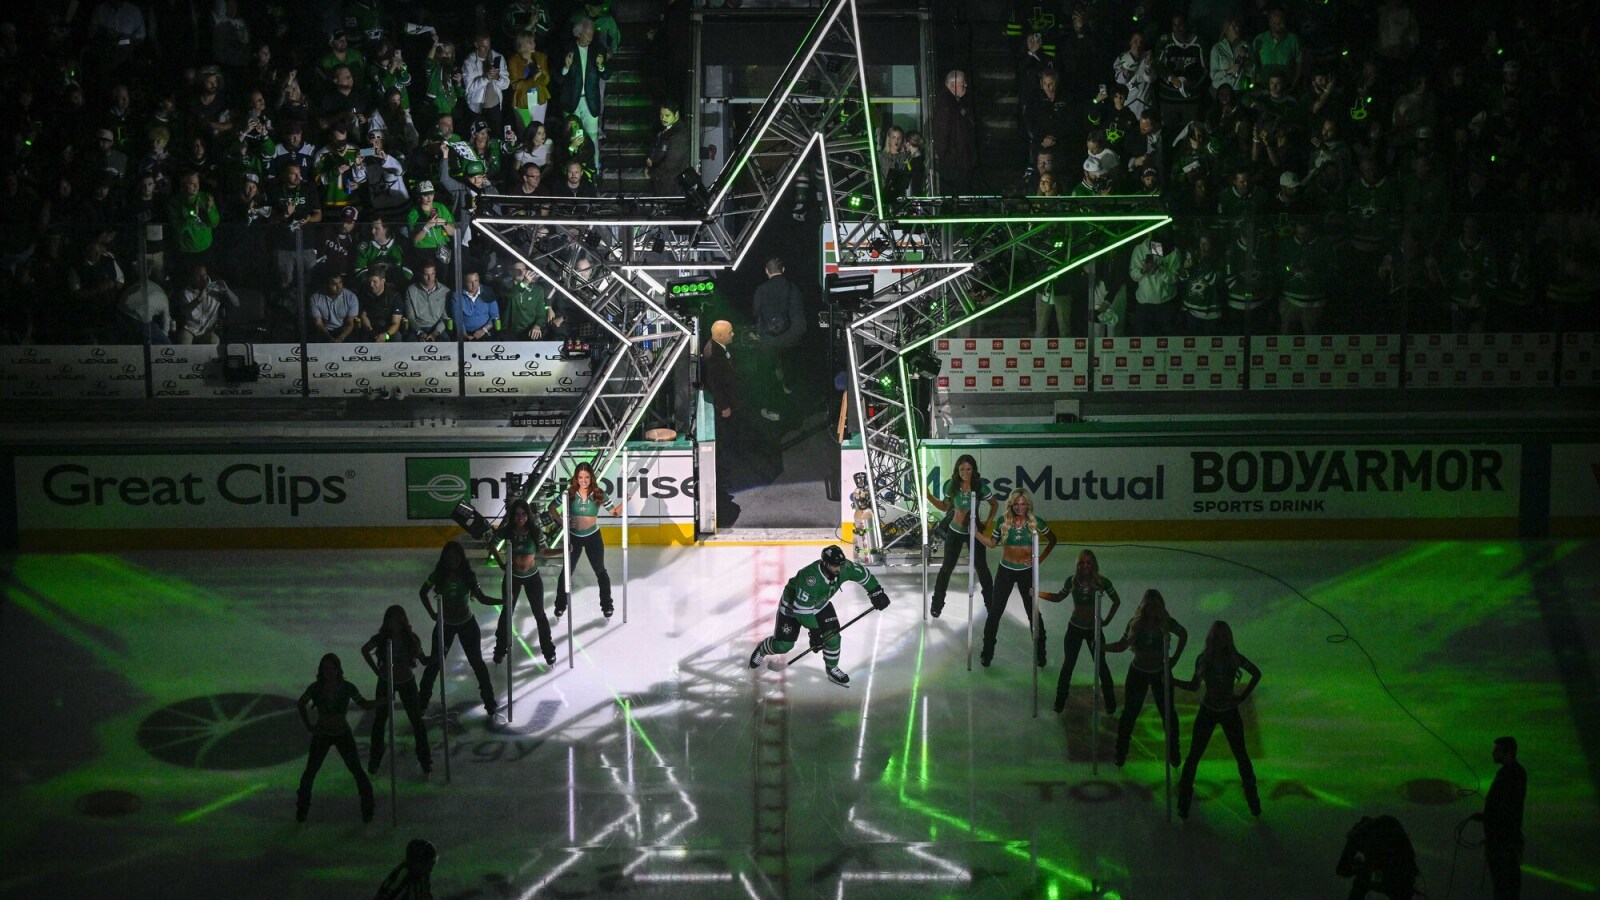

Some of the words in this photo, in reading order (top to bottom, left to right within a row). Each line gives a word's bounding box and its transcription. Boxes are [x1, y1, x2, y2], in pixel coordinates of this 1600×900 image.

[43, 464, 204, 507] Great
[904, 464, 1164, 501] MsMutual
[1190, 448, 1504, 493] BODYARMOR
[1193, 501, 1263, 513] SPORTS
[1270, 500, 1325, 512] DRINK
[797, 588, 809, 602] 15
